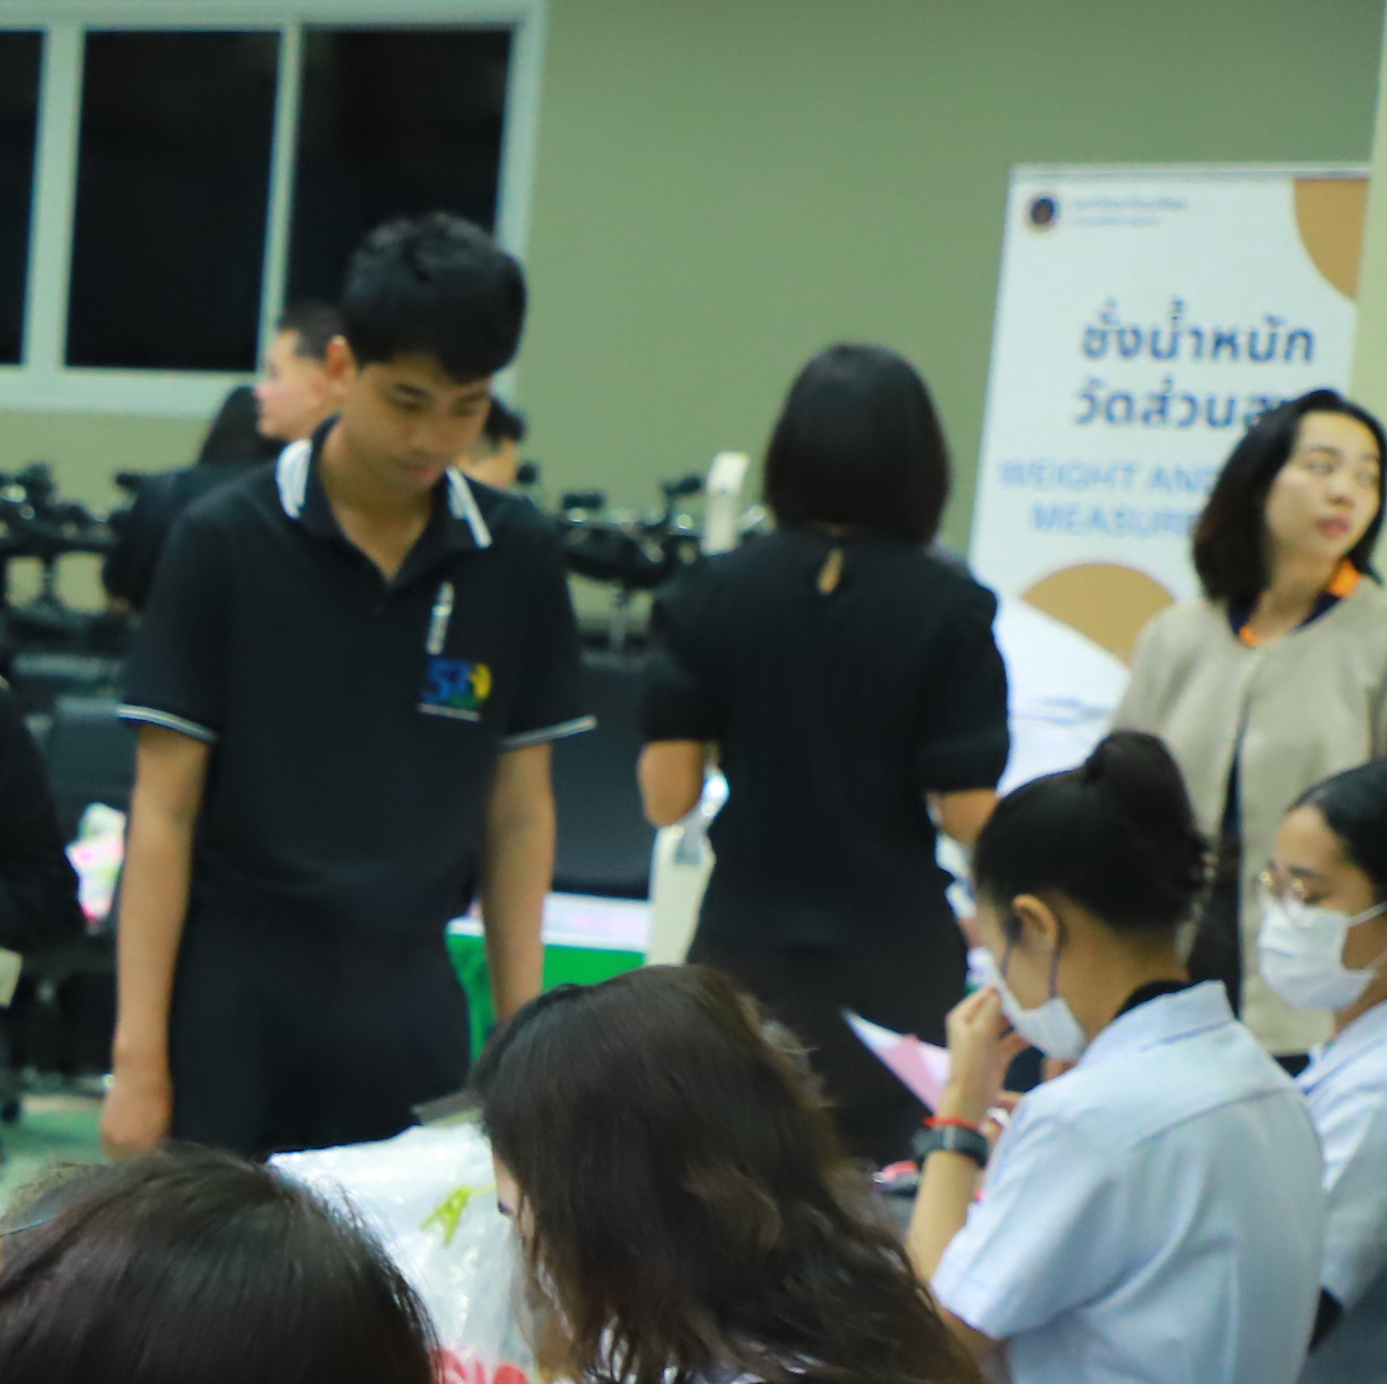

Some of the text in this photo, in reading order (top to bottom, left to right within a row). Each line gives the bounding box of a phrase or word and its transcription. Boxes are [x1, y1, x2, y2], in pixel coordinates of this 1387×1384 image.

[1082, 296, 1315, 363] ชั่งน้ำหนัก
[1074, 374, 1295, 429] วัดส่วนส
[1001, 457, 1138, 492] WEIGHT
